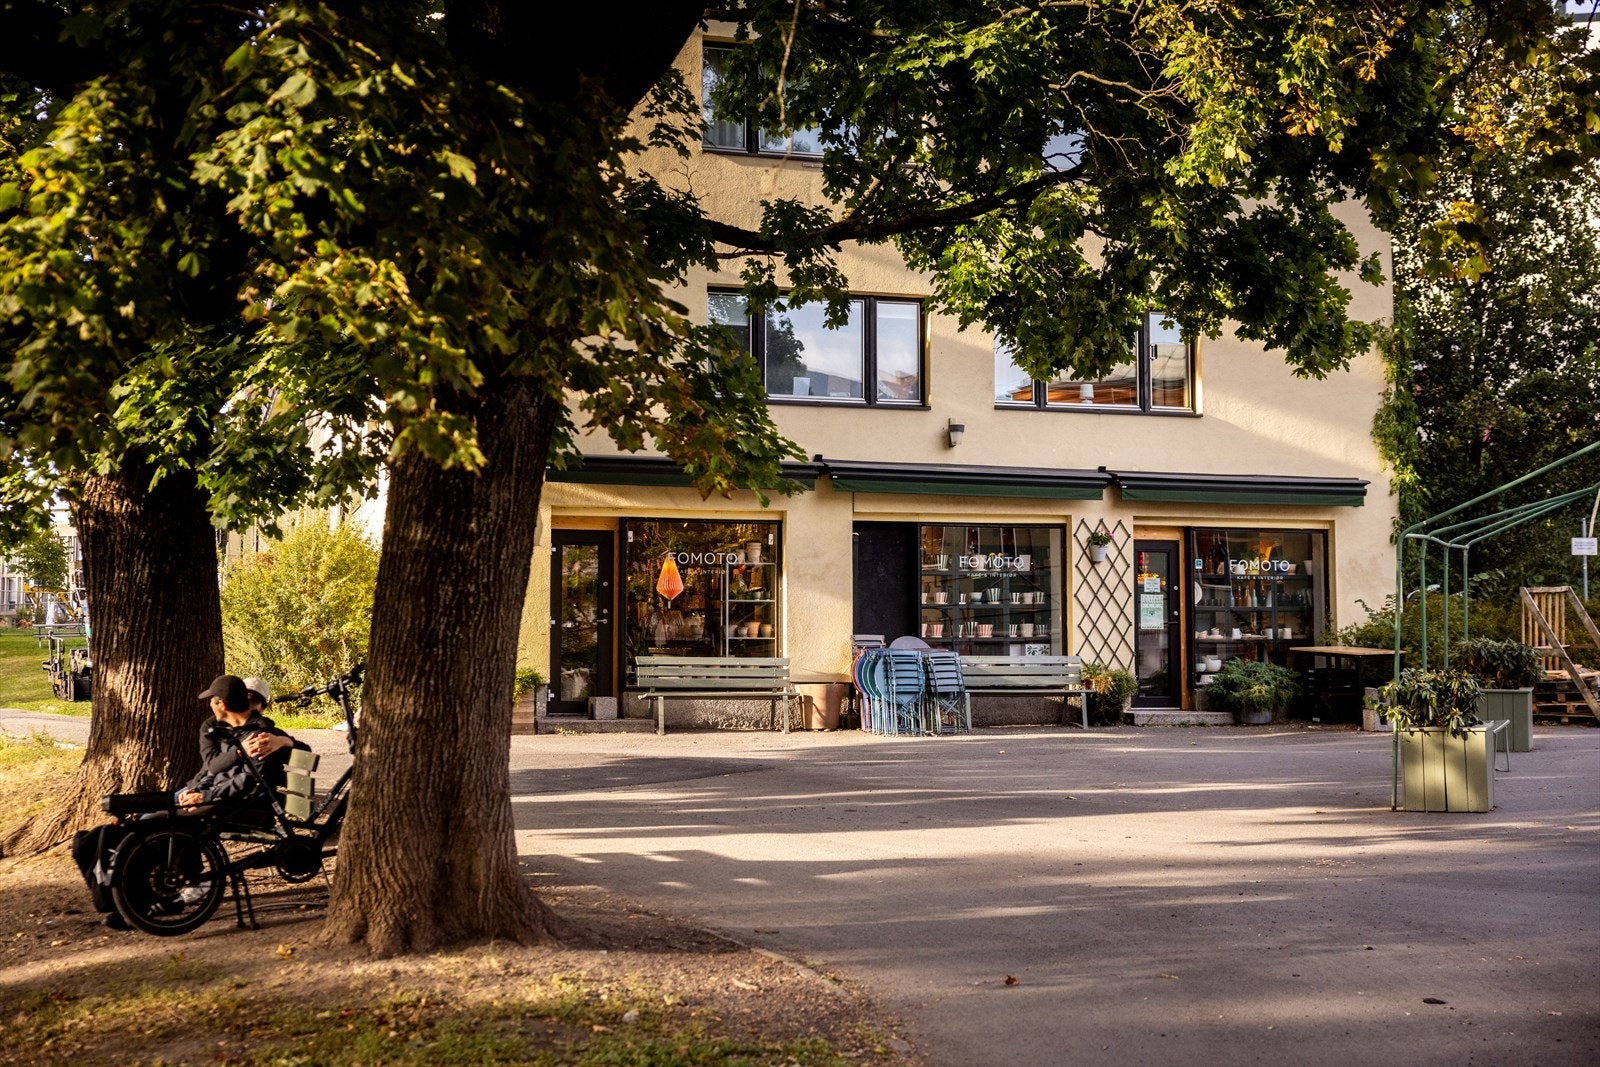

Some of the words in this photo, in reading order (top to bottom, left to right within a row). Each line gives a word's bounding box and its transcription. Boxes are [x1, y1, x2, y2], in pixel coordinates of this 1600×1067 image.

[668, 552, 738, 564] FOMOTO
[959, 556, 1024, 568] FOMOTO
[1229, 559, 1290, 571] FOMOTO
